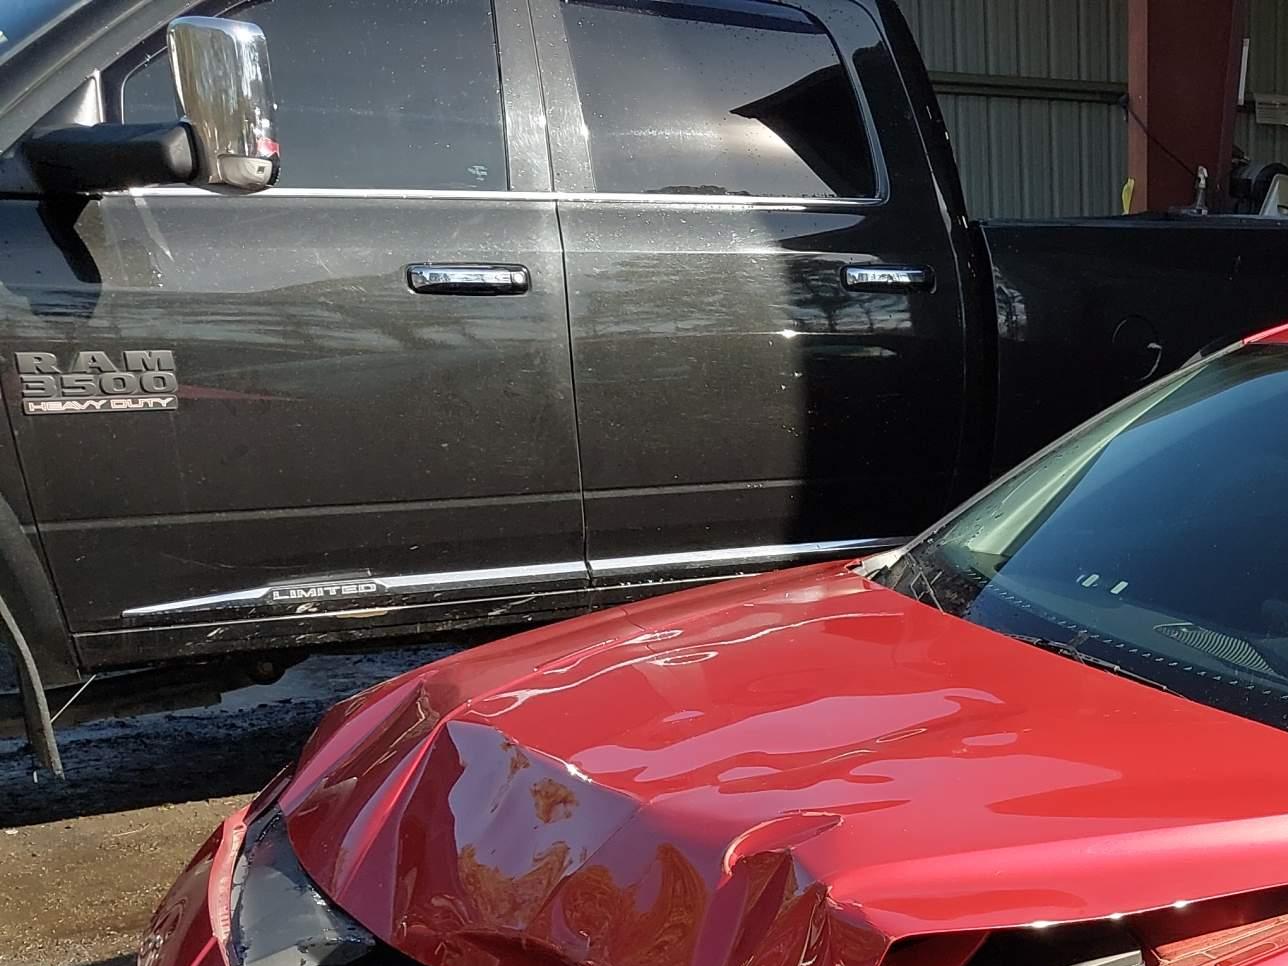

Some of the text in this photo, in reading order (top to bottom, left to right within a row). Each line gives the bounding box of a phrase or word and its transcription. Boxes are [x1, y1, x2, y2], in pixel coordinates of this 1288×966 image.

[15, 350, 178, 374] RAM
[20, 371, 178, 397] 3500
[28, 397, 174, 412] HEAVY DUTY
[272, 582, 377, 600] LIMITED
